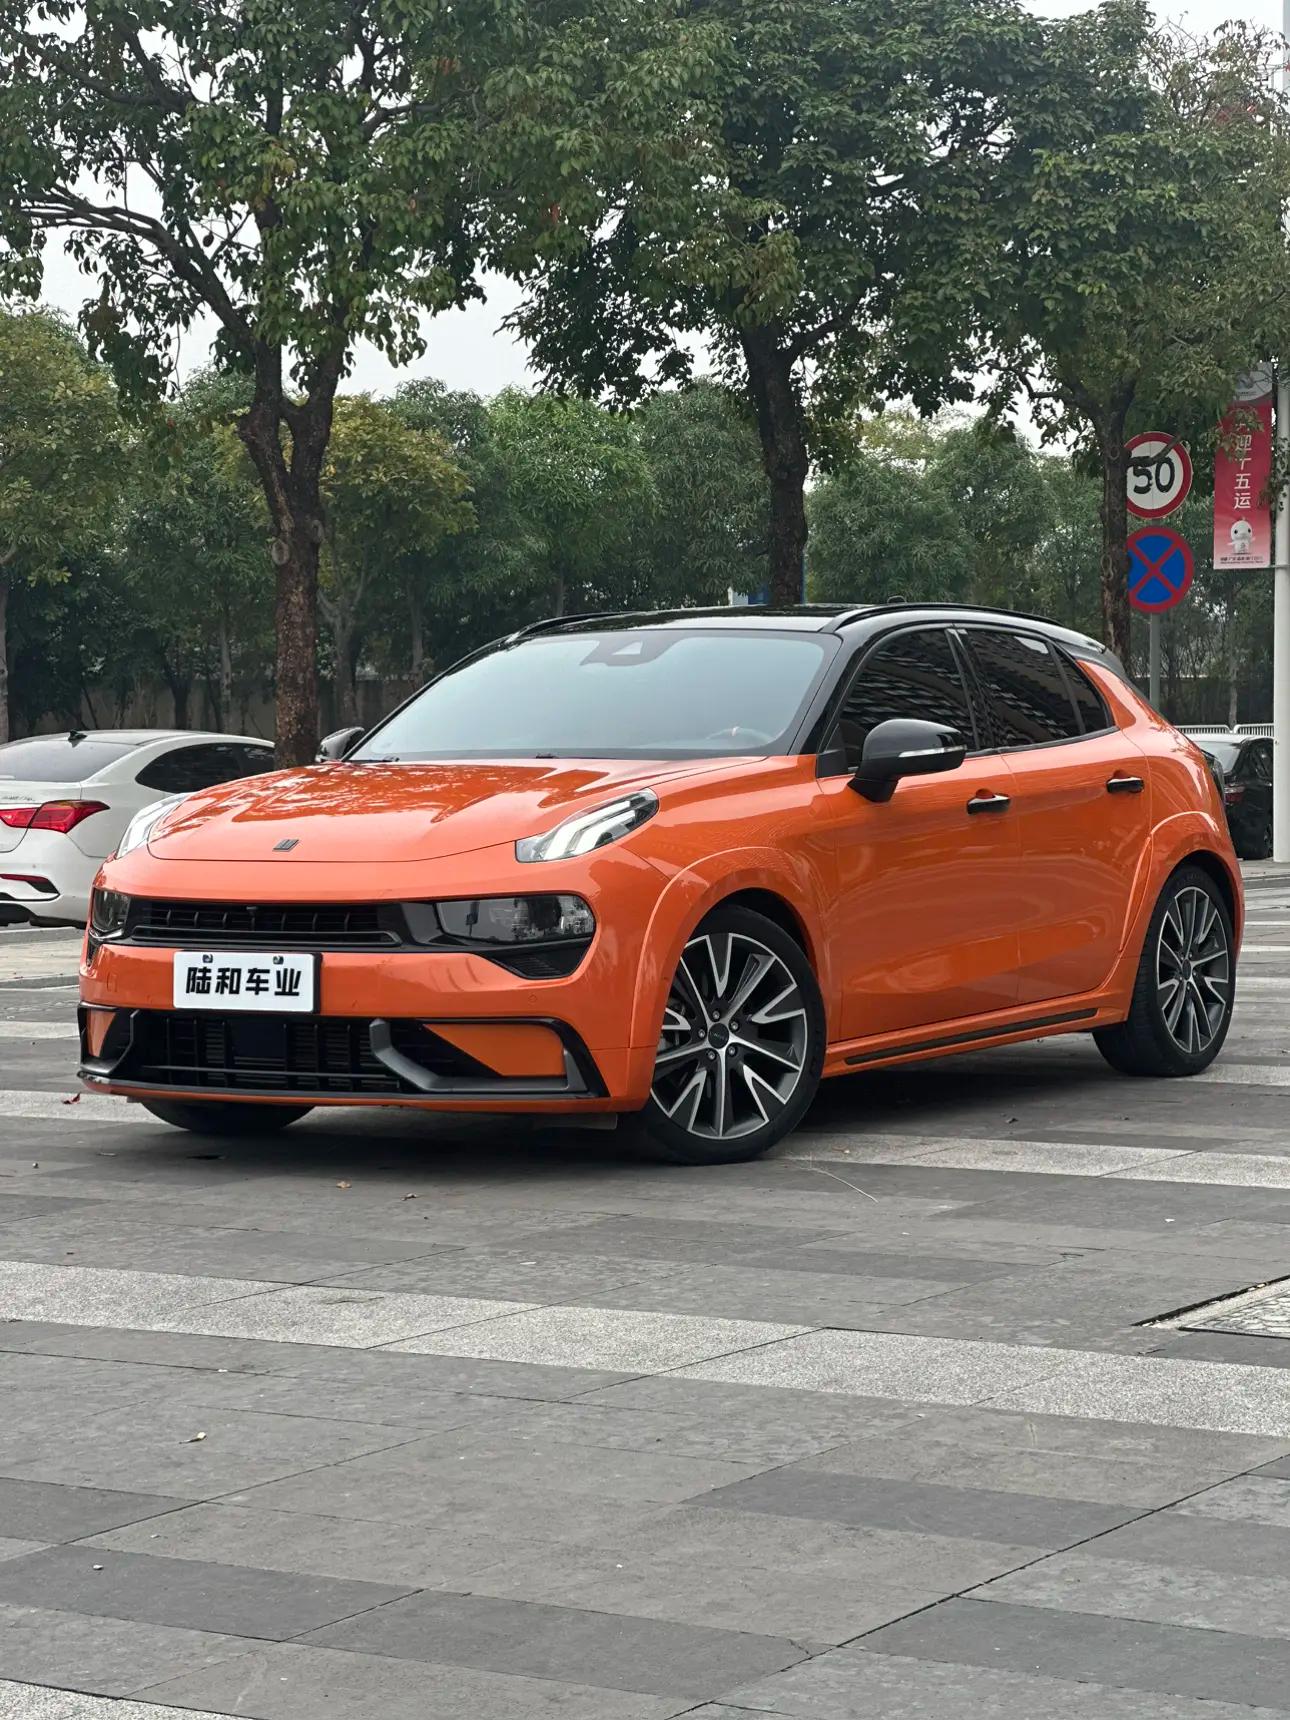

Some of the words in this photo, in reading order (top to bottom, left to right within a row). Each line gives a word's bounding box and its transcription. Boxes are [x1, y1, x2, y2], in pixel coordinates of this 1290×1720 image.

[1133, 457, 1175, 494] 50
[186, 966, 302, 997] 陆和车业
